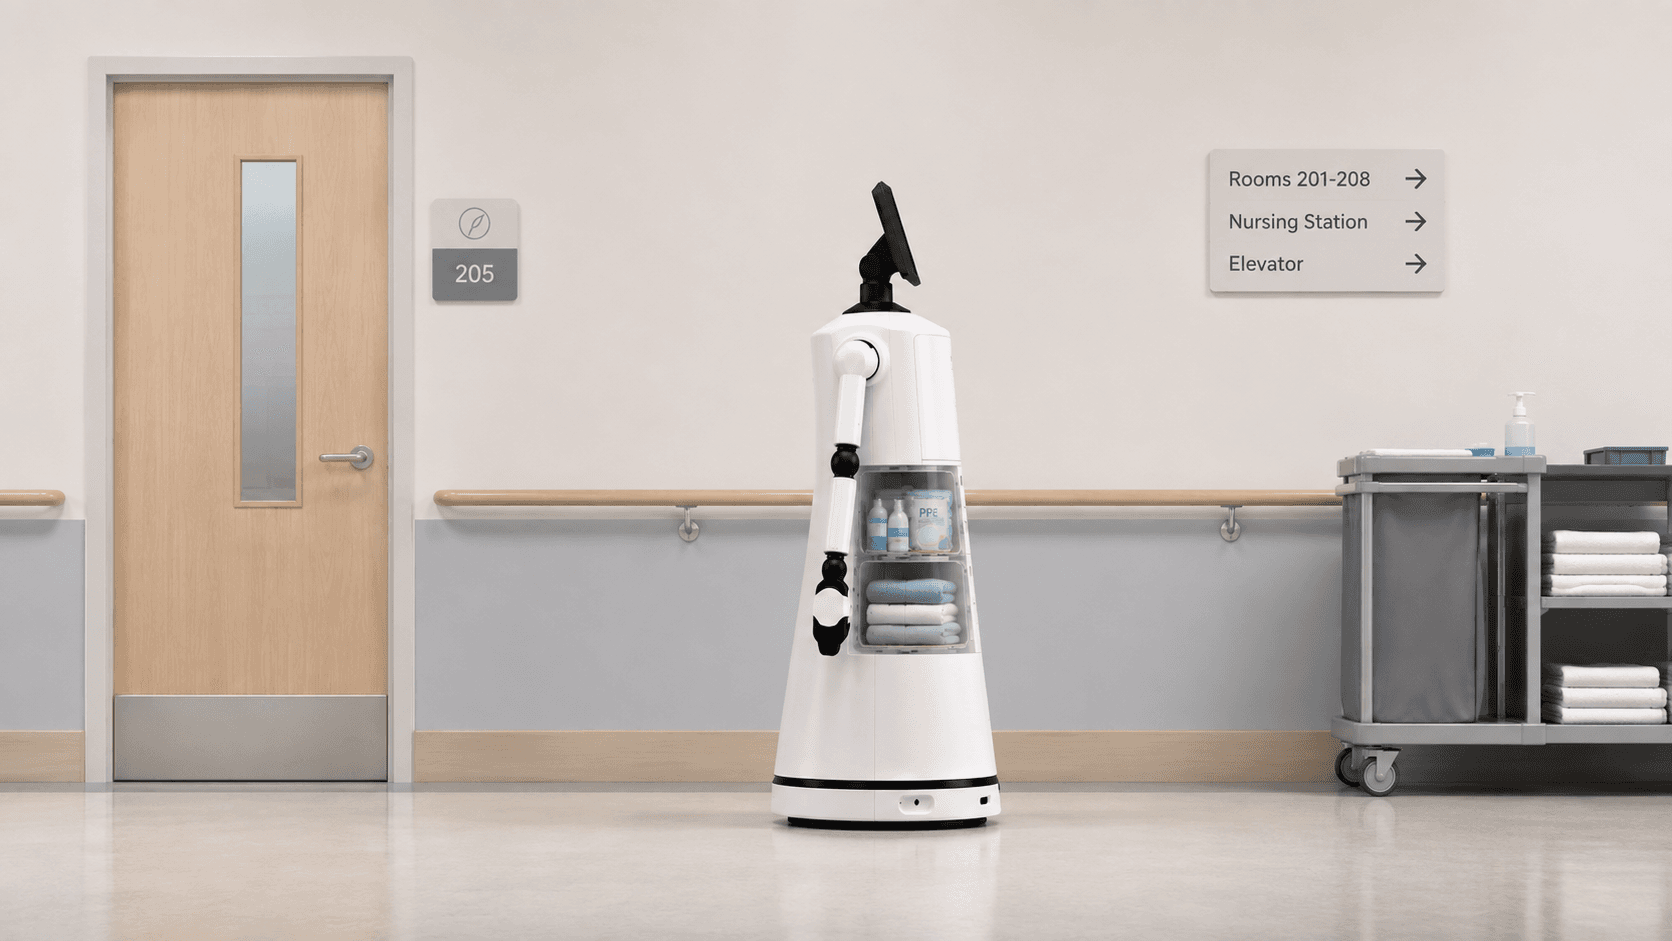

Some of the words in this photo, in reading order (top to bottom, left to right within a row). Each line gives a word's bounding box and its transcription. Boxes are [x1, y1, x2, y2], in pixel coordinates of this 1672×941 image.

[1229, 170, 1291, 187] Rooms
[1297, 170, 1371, 187] 201-208
[1229, 213, 1298, 233] Nursing
[1304, 213, 1368, 230] Station
[1229, 254, 1304, 272] Elevator
[455, 264, 494, 283] 205
[919, 507, 938, 518] PPE
